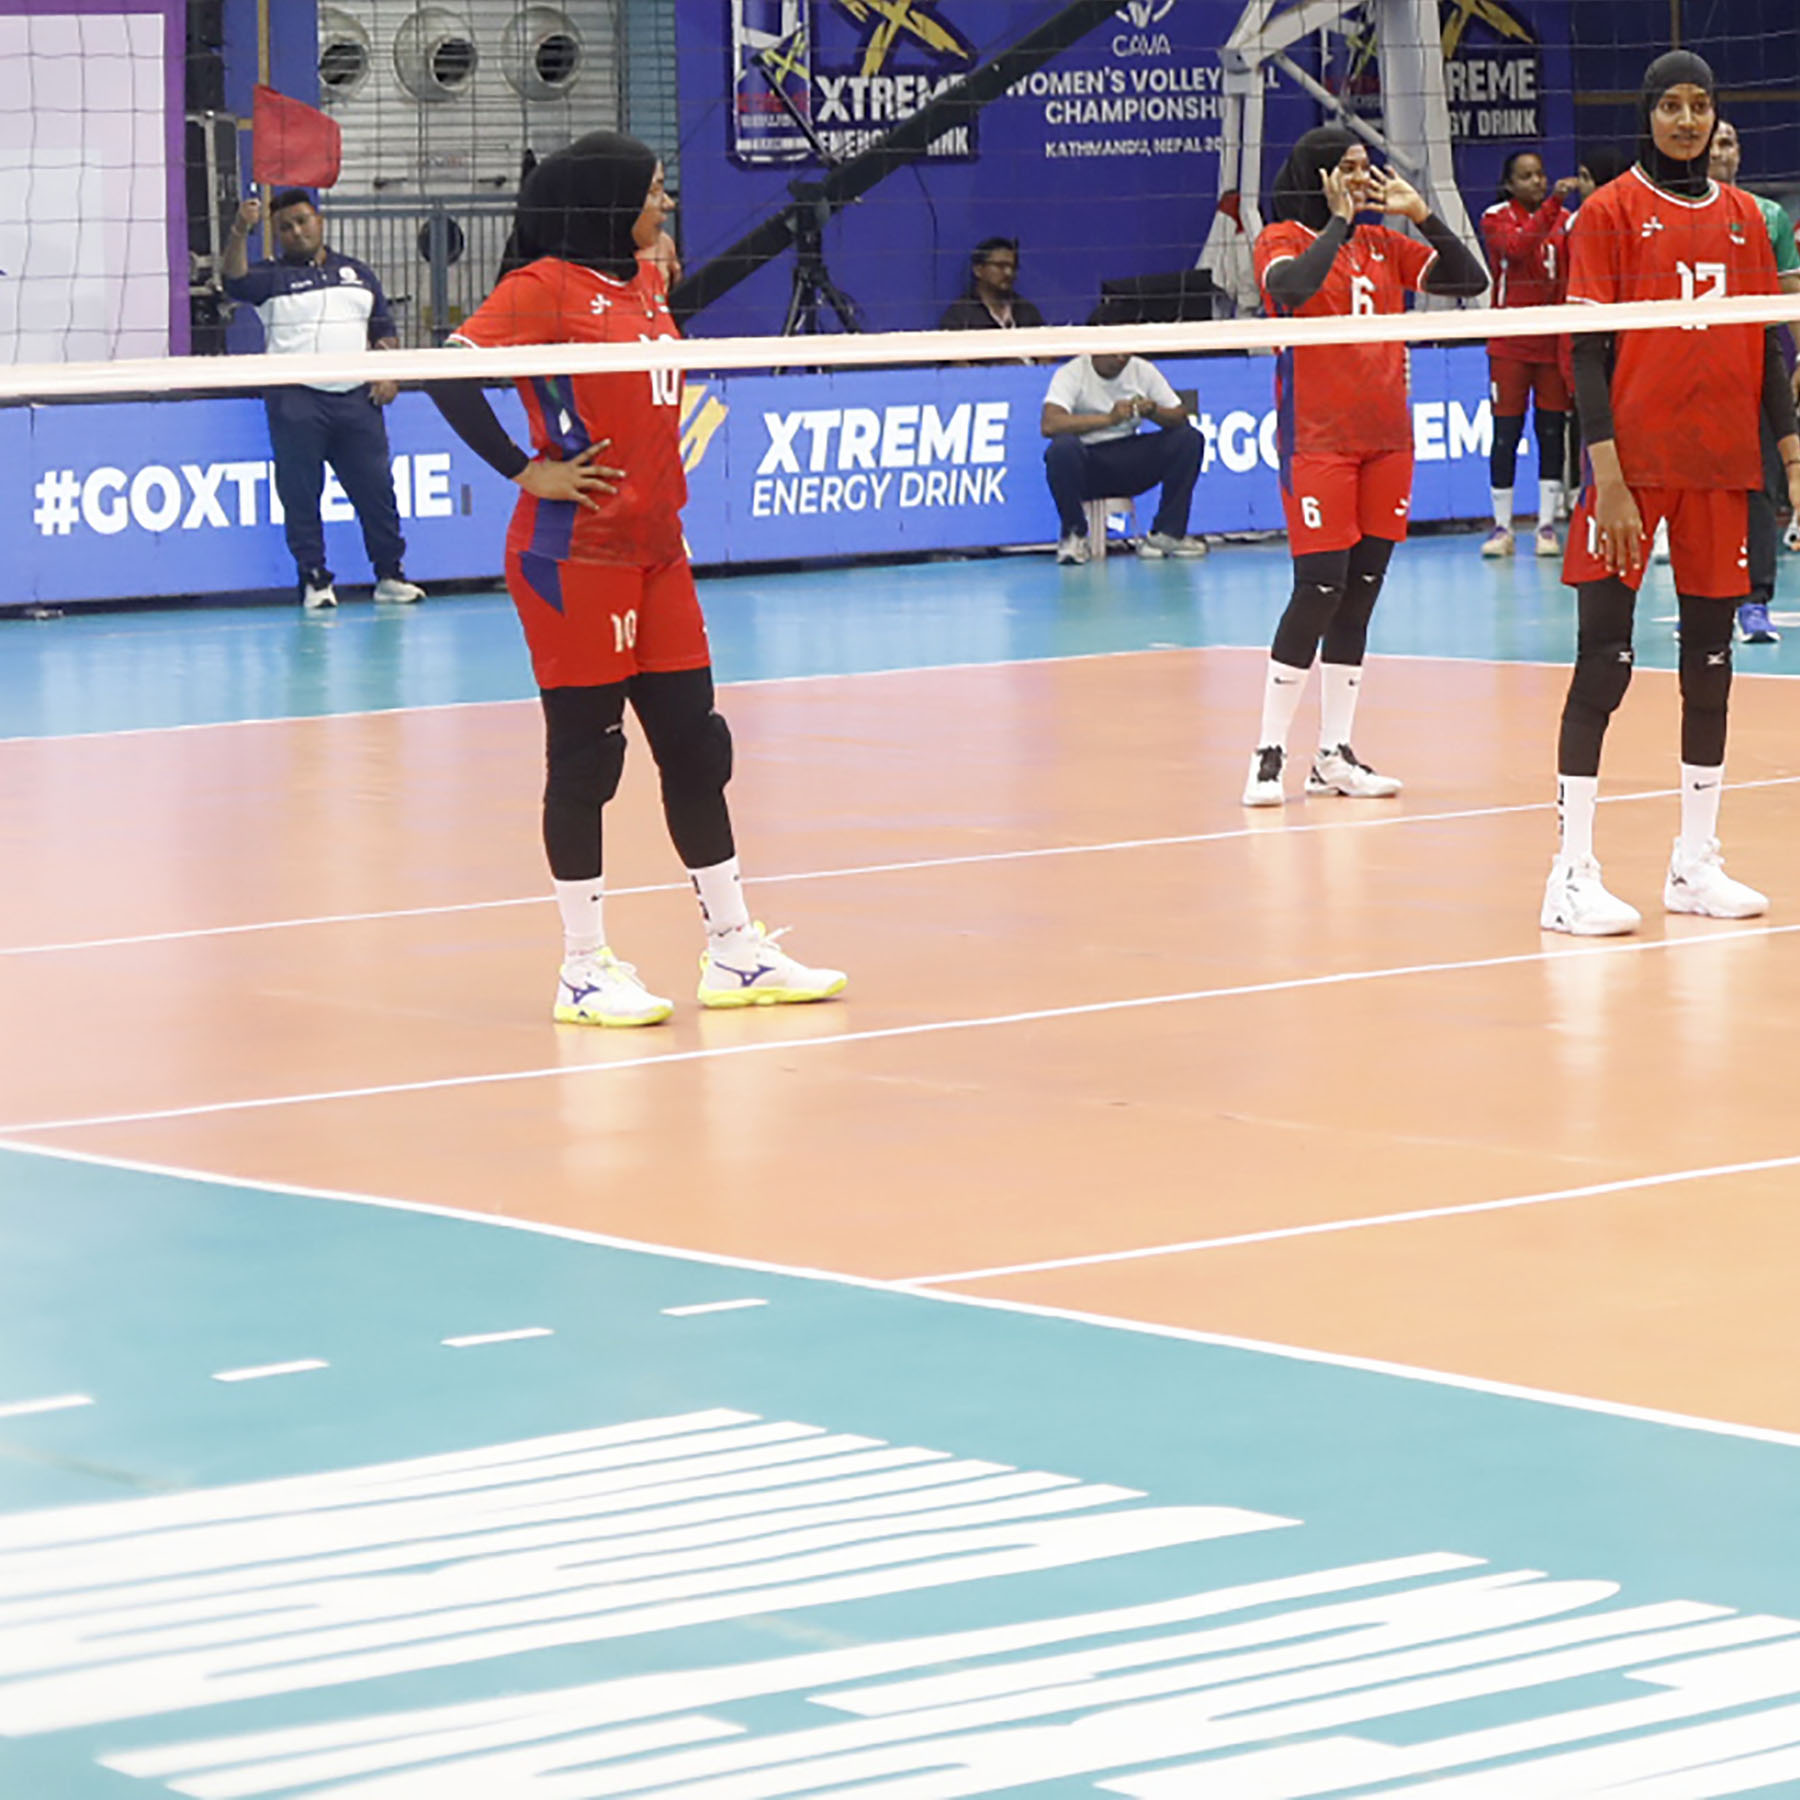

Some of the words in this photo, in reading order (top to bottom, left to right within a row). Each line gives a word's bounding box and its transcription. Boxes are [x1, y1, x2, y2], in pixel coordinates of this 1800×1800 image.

[1112, 34, 1171, 57] CAVA
[815, 73, 967, 122] XTRE
[1445, 59, 1537, 102] REME
[1045, 96, 1226, 124] CHAMPIONSH
[1479, 109, 1538, 136] DRINK
[1351, 275, 1376, 316] 6
[756, 402, 1010, 475] XTREME
[752, 472, 892, 517] ENERGY
[899, 466, 1007, 507] DRINK
[1301, 496, 1323, 529] 6
[611, 609, 638, 653] 10
